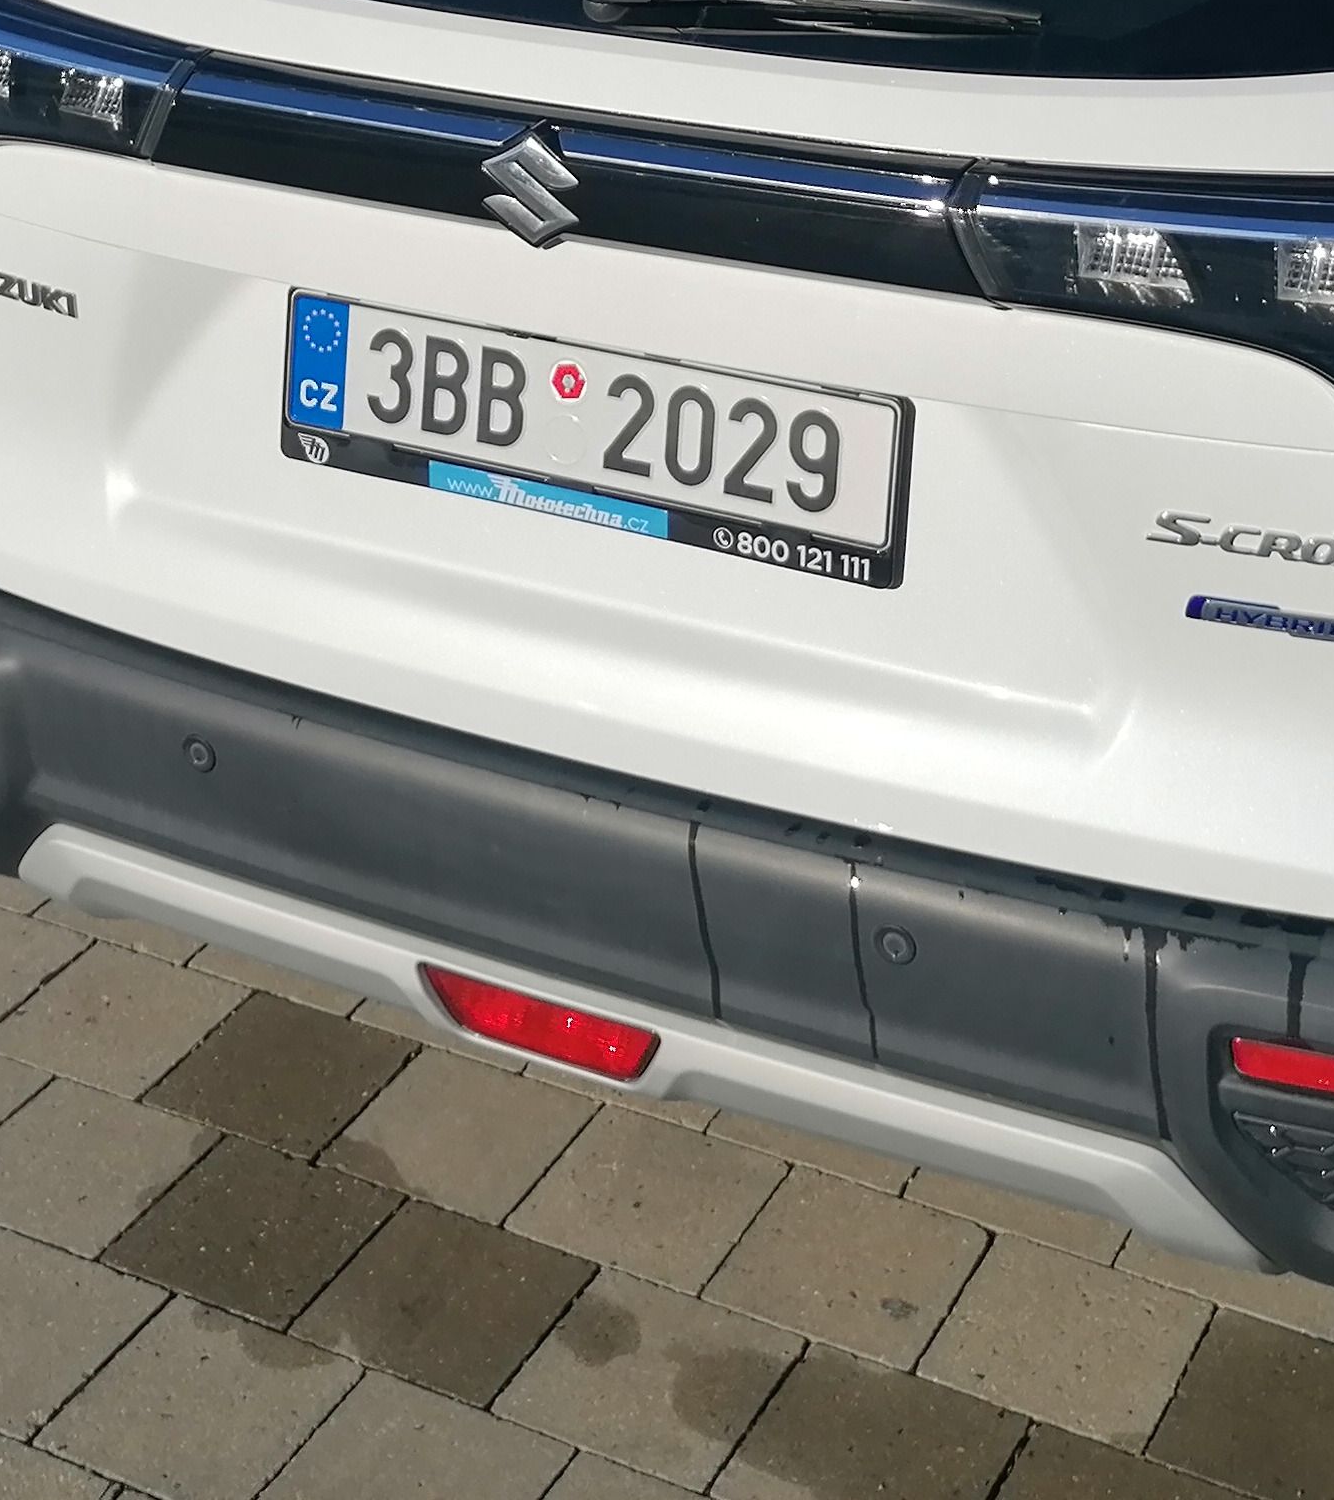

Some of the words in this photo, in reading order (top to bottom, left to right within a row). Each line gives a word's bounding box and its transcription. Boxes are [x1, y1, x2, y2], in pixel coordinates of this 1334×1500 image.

[299, 379, 338, 412] CZ
[367, 327, 529, 448] 3BB
[602, 373, 842, 513] 2029
[736, 531, 790, 563] 800
[796, 544, 833, 573] 121
[840, 554, 871, 581] 111
